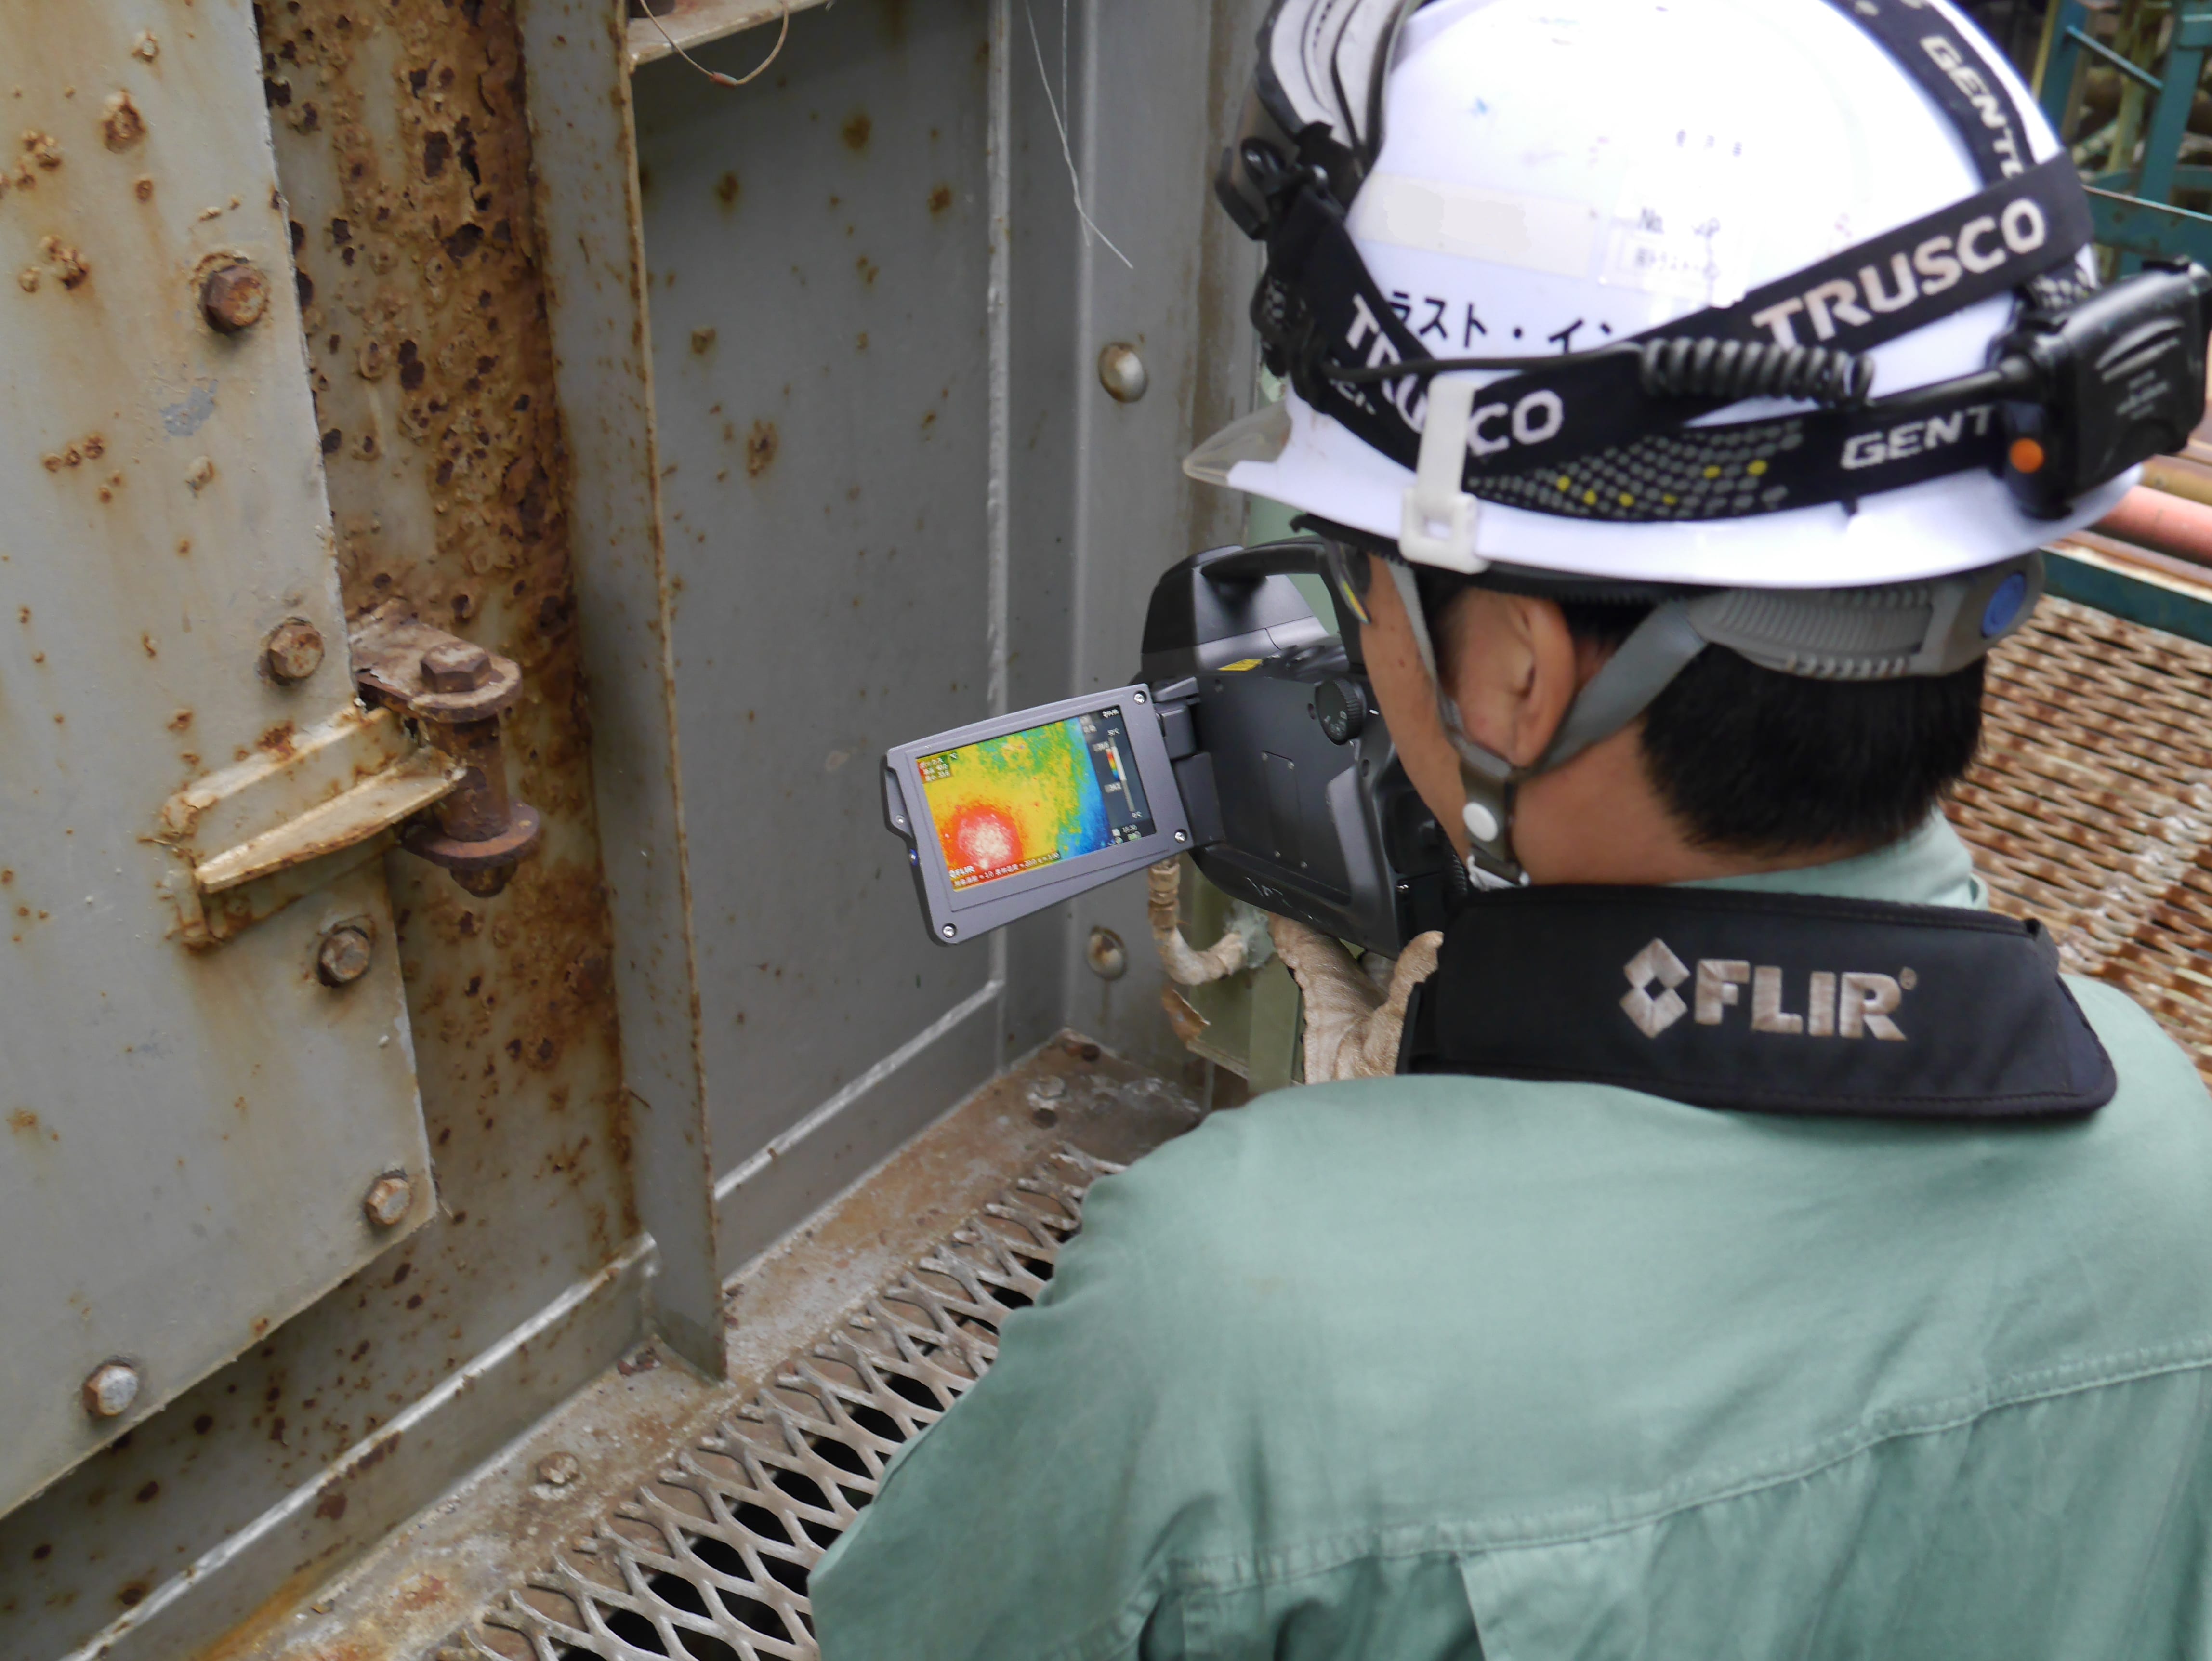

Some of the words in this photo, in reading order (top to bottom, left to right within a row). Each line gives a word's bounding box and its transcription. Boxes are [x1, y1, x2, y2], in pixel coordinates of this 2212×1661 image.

[1751, 198, 2046, 350] TRUSCO
[1389, 291, 1611, 354] ラスト・イ
[956, 865, 975, 876] FLIR
